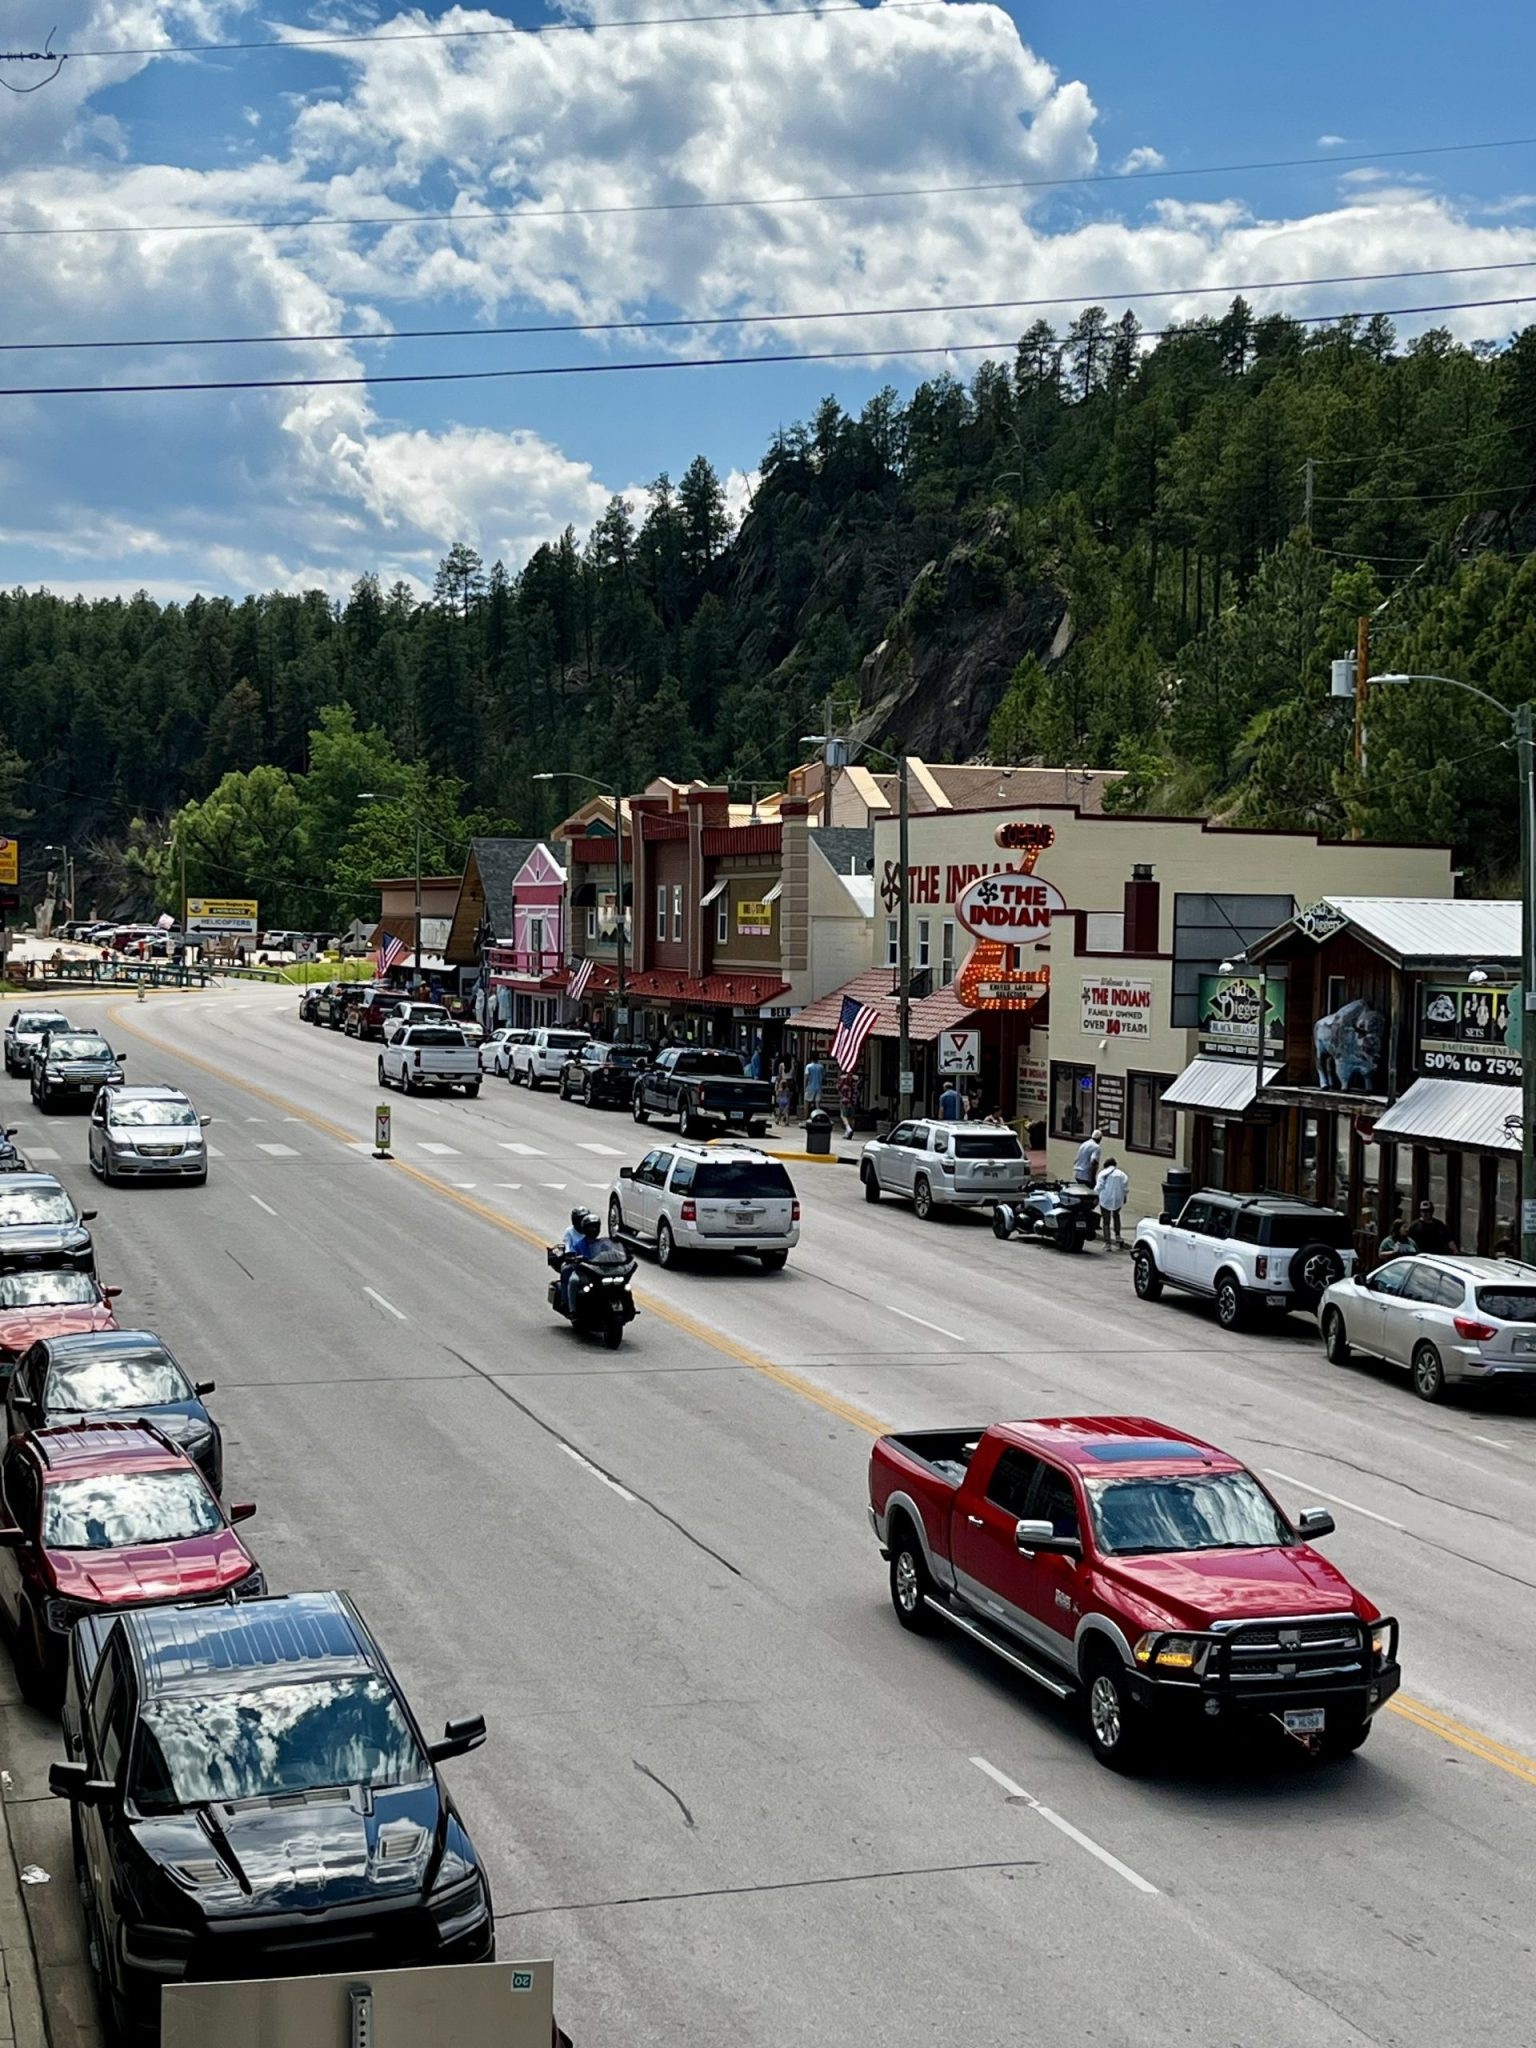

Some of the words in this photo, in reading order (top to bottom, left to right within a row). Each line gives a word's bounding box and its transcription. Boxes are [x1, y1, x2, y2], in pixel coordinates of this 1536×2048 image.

[907, 865, 940, 904] THE
[1000, 885, 1047, 906] THE
[970, 905, 1050, 927] INDIAN
[1092, 988, 1108, 1005] THE
[1112, 989, 1150, 1008] INDIANS
[1216, 979, 1247, 1003] Gold
[771, 1007, 791, 1017] BEER
[1088, 1008, 1113, 1017] FAMILY
[1115, 1010, 1143, 1019] OWNED
[1221, 996, 1261, 1020] Digger
[1083, 1019, 1105, 1029] OVER
[1122, 1022, 1147, 1033] YEARS
[1212, 1022, 1231, 1033] BLACK
[1465, 1028, 1485, 1037] SETS
[1441, 1044, 1480, 1053] FACTORY
[1425, 1053, 1460, 1070] 50%
[1464, 1057, 1481, 1072] to
[1486, 1058, 1523, 1076] 75%
